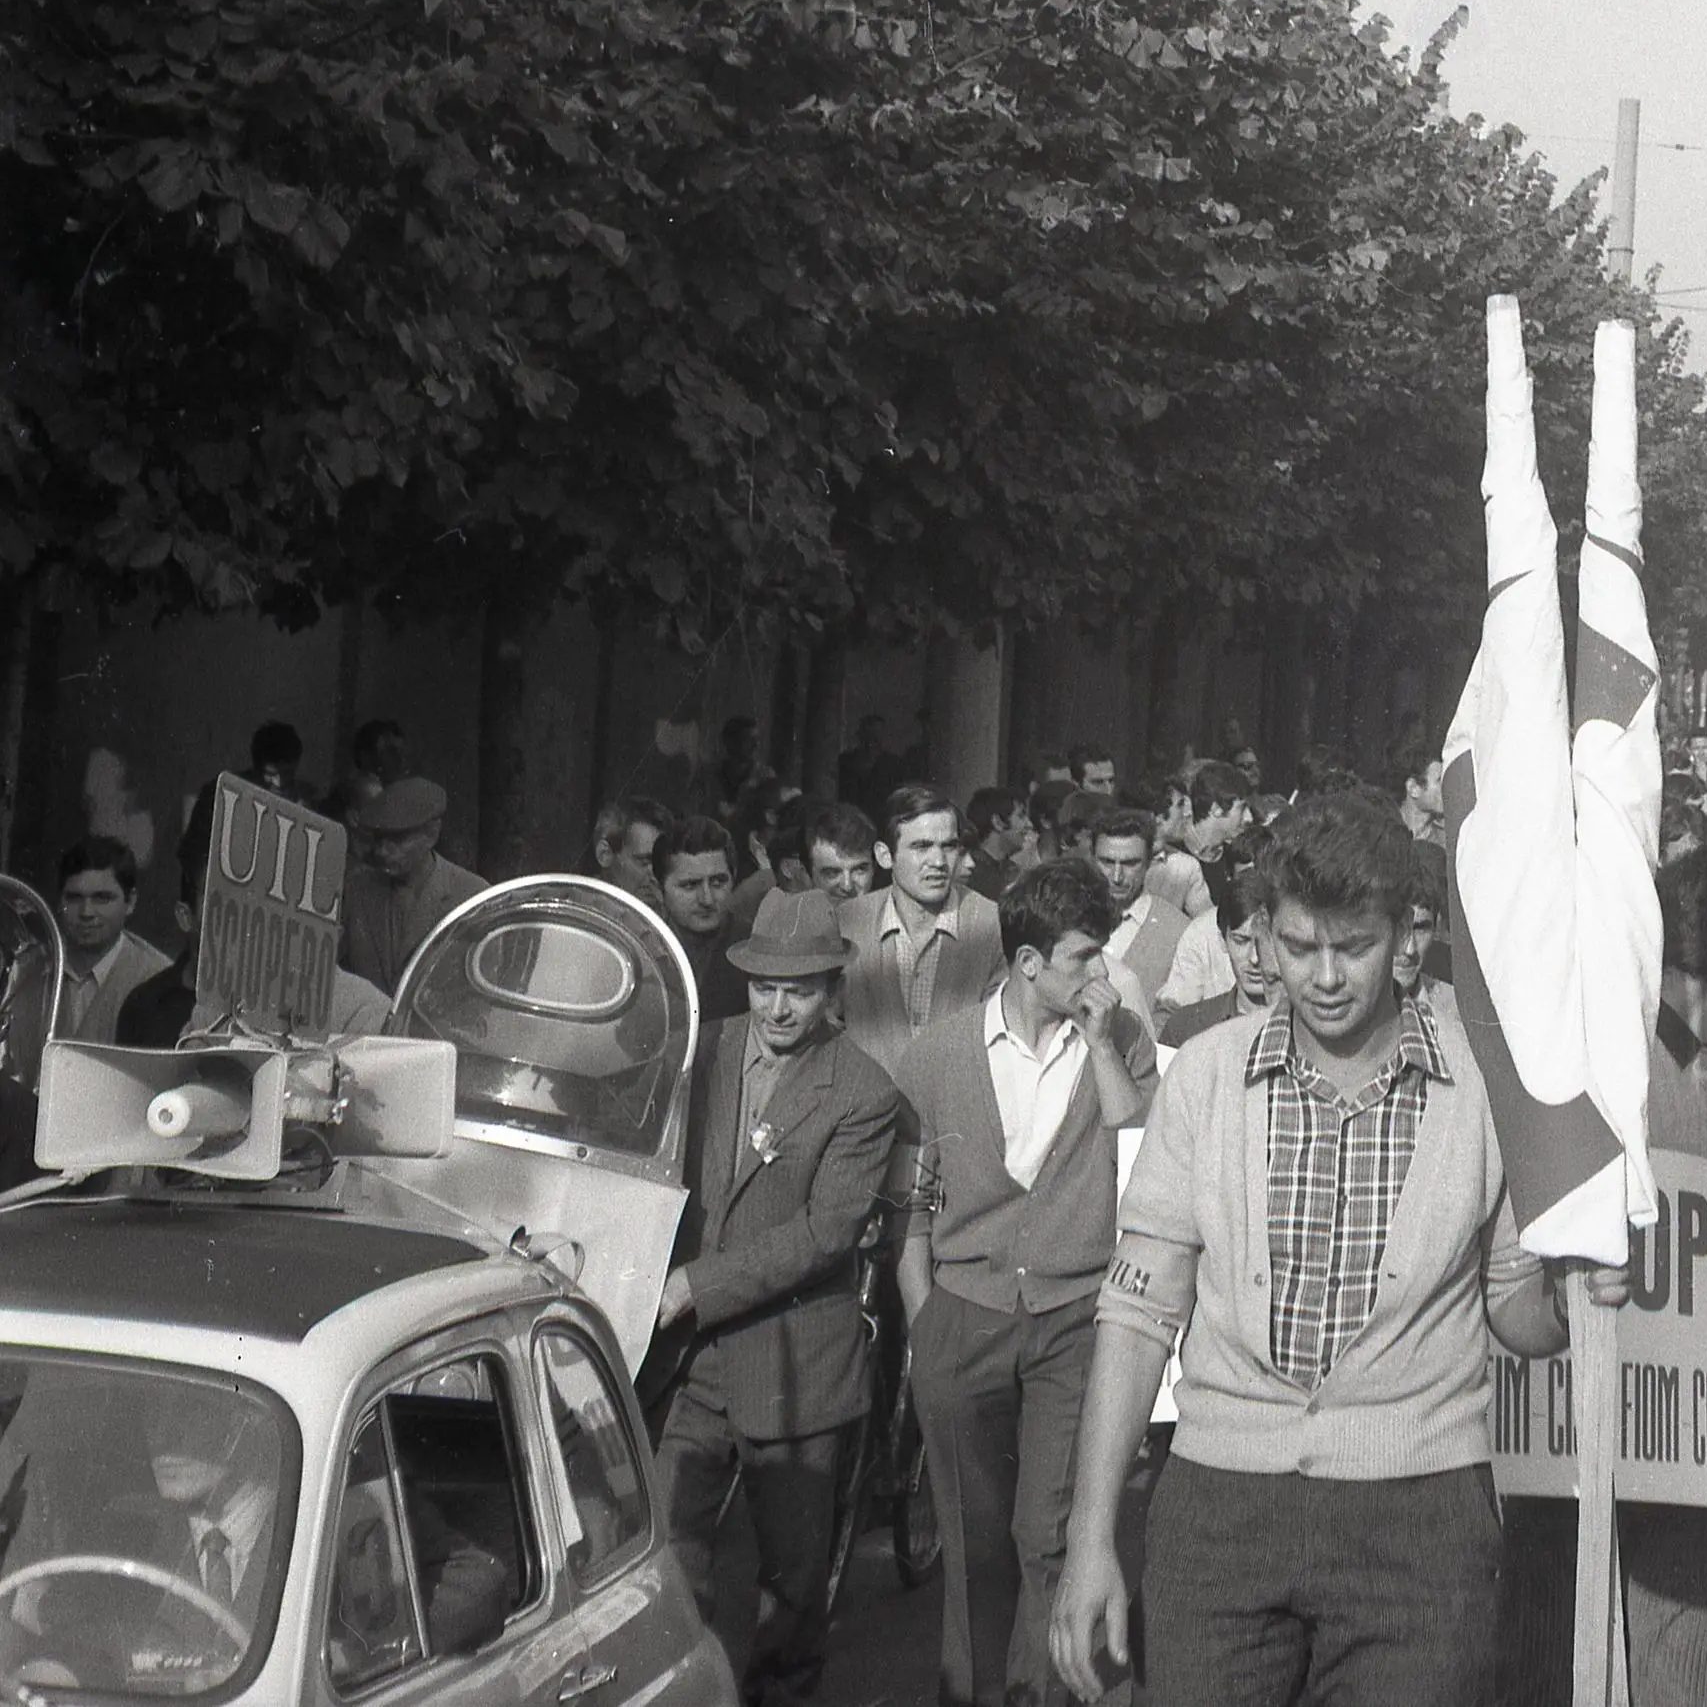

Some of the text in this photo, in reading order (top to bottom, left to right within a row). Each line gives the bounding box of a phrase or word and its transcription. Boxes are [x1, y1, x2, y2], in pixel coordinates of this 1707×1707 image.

[220, 789, 341, 923] UIL
[202, 892, 336, 1031] SCIOPERO
[1488, 1354, 1531, 1455] IM
[1547, 1357, 1578, 1457] CI
[1621, 1362, 1680, 1463] FIOM
